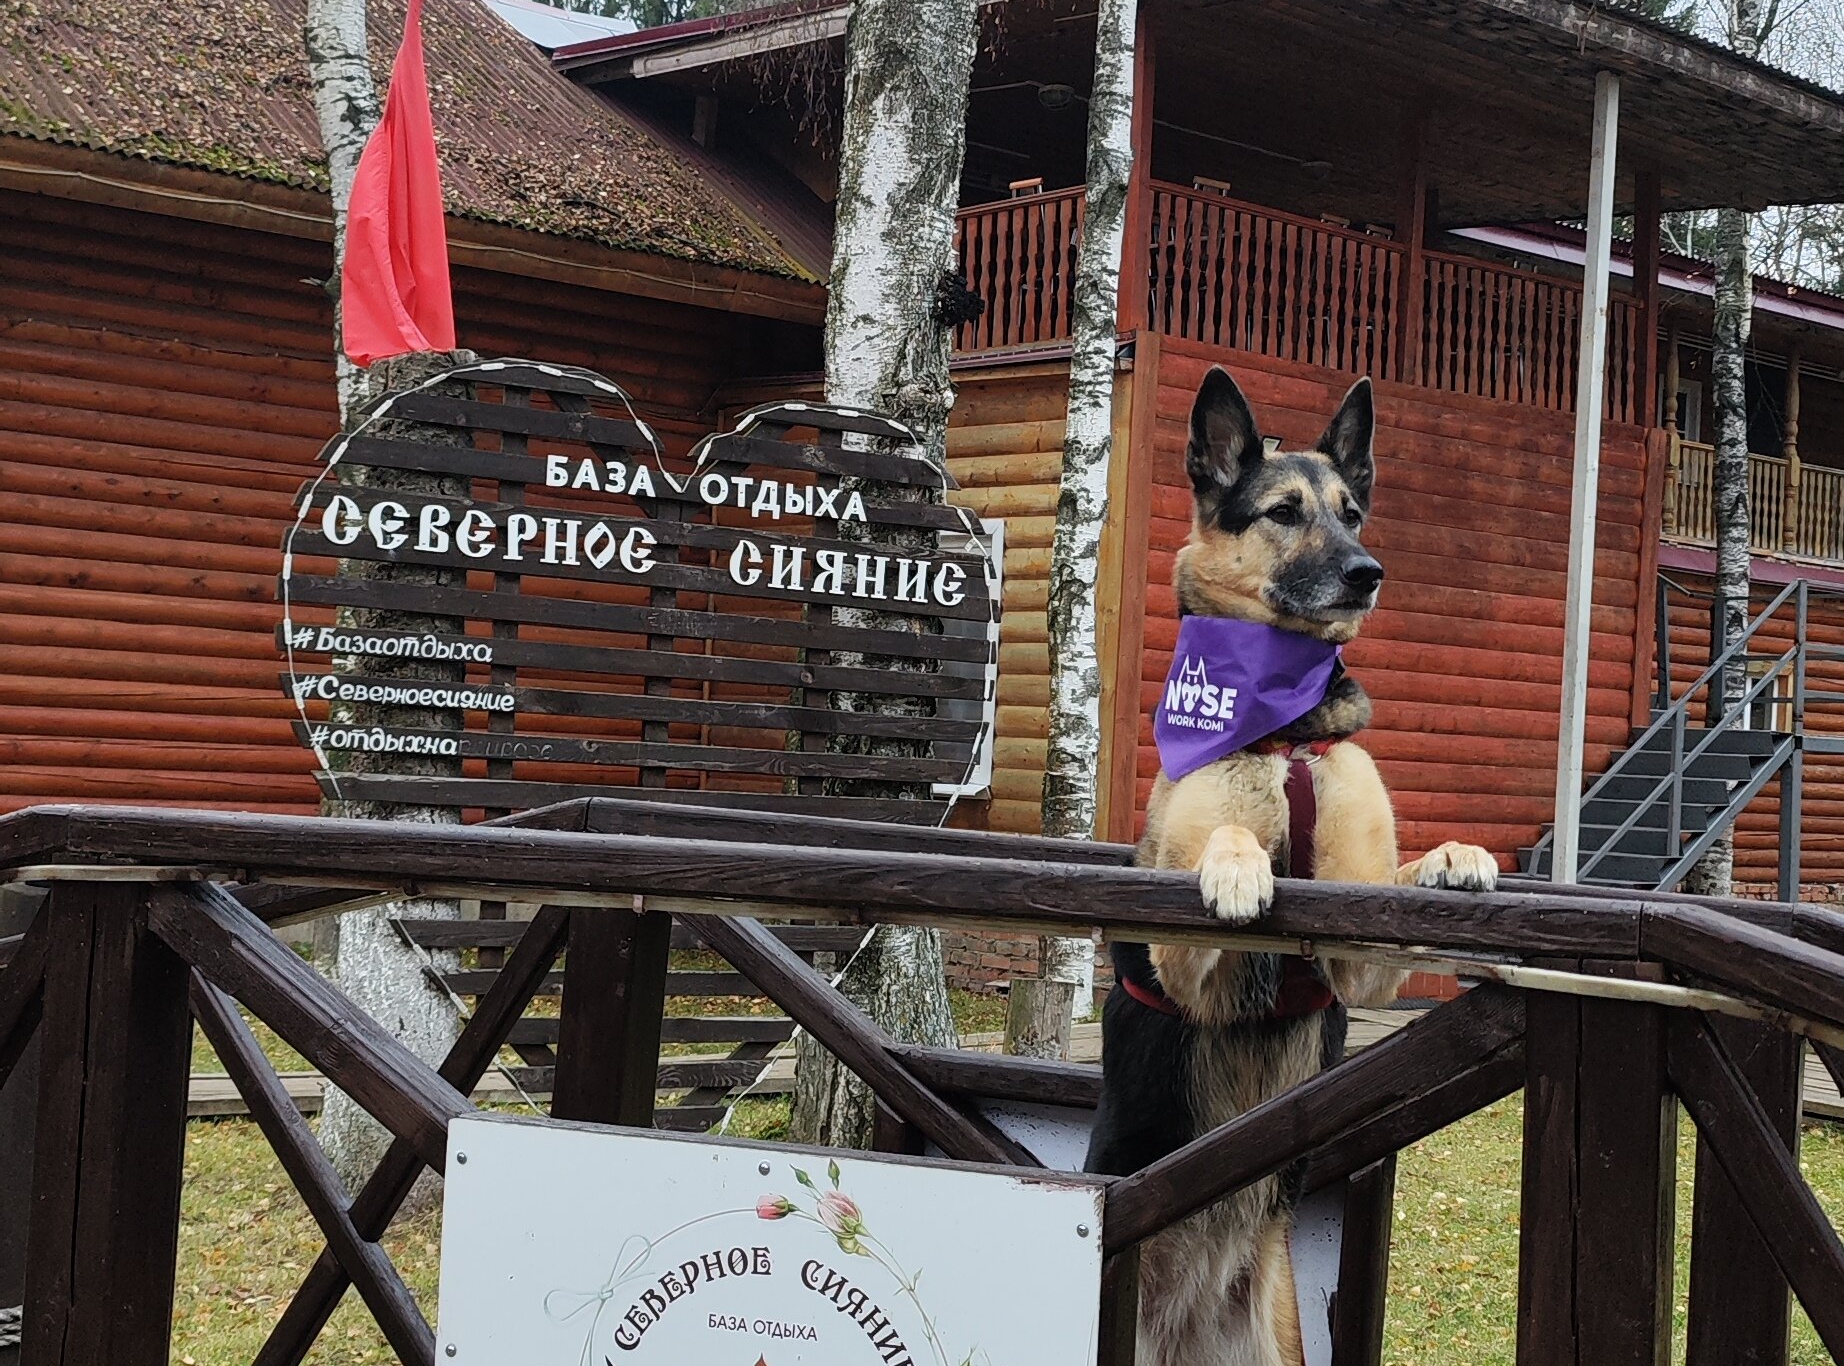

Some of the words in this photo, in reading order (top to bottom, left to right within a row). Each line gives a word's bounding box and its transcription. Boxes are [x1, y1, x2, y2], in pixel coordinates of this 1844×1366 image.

[545, 454, 656, 497] БАЗА
[699, 473, 868, 522] ОТДЫХА
[322, 495, 657, 573] СЕВЕРНОЕ
[729, 539, 967, 606] СИЯНИЕ
[291, 627, 493, 663] #Базаотдыха
[298, 674, 515, 712] #Северноесияние
[1167, 713, 1196, 728] WORK
[1197, 718, 1224, 732] KOMI
[614, 1246, 772, 1351] СЕВЕРНОЕ
[708, 1313, 748, 1333] БАЗА
[752, 1319, 818, 1342] ОТДЫХА
